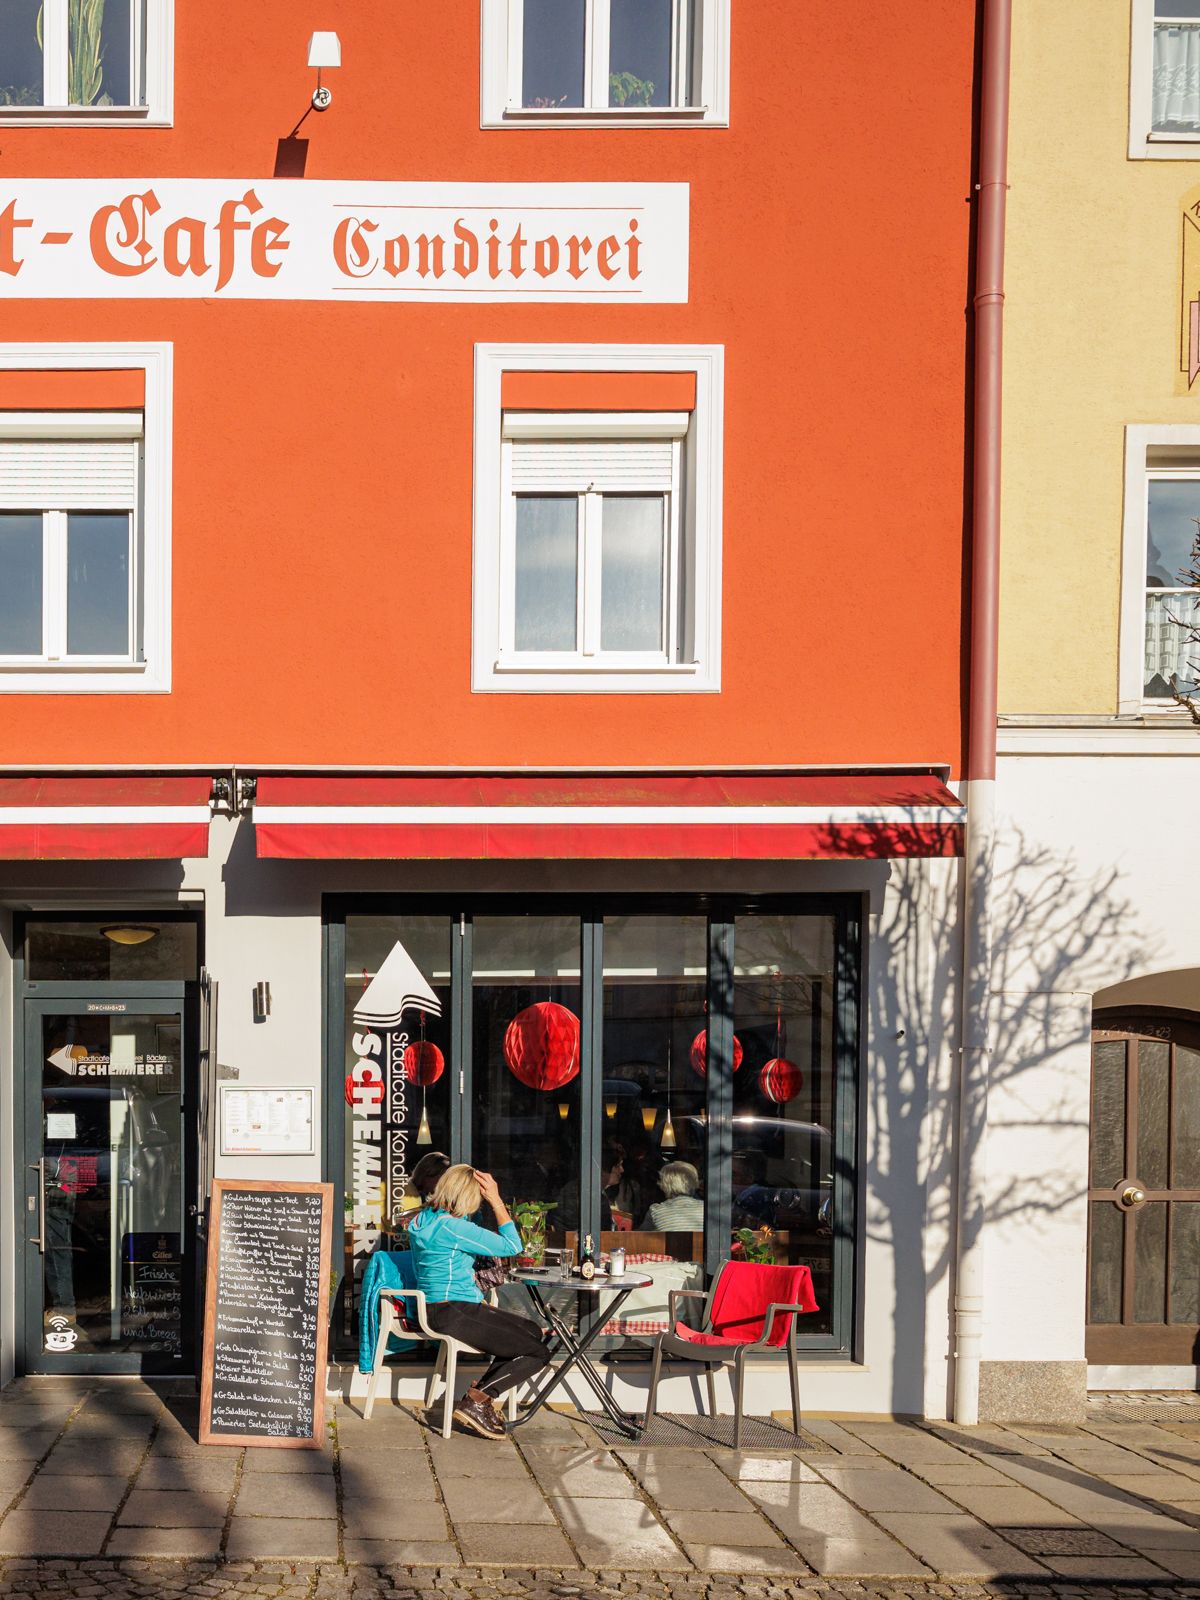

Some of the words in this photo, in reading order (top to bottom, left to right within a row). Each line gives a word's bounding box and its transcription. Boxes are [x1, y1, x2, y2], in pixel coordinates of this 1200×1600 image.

[333, 217, 643, 281] Conditorei
[392, 1032, 409, 1124] Stadtcafe
[352, 1031, 382, 1298] SCHEMMER
[139, 1265, 176, 1280] Frische
